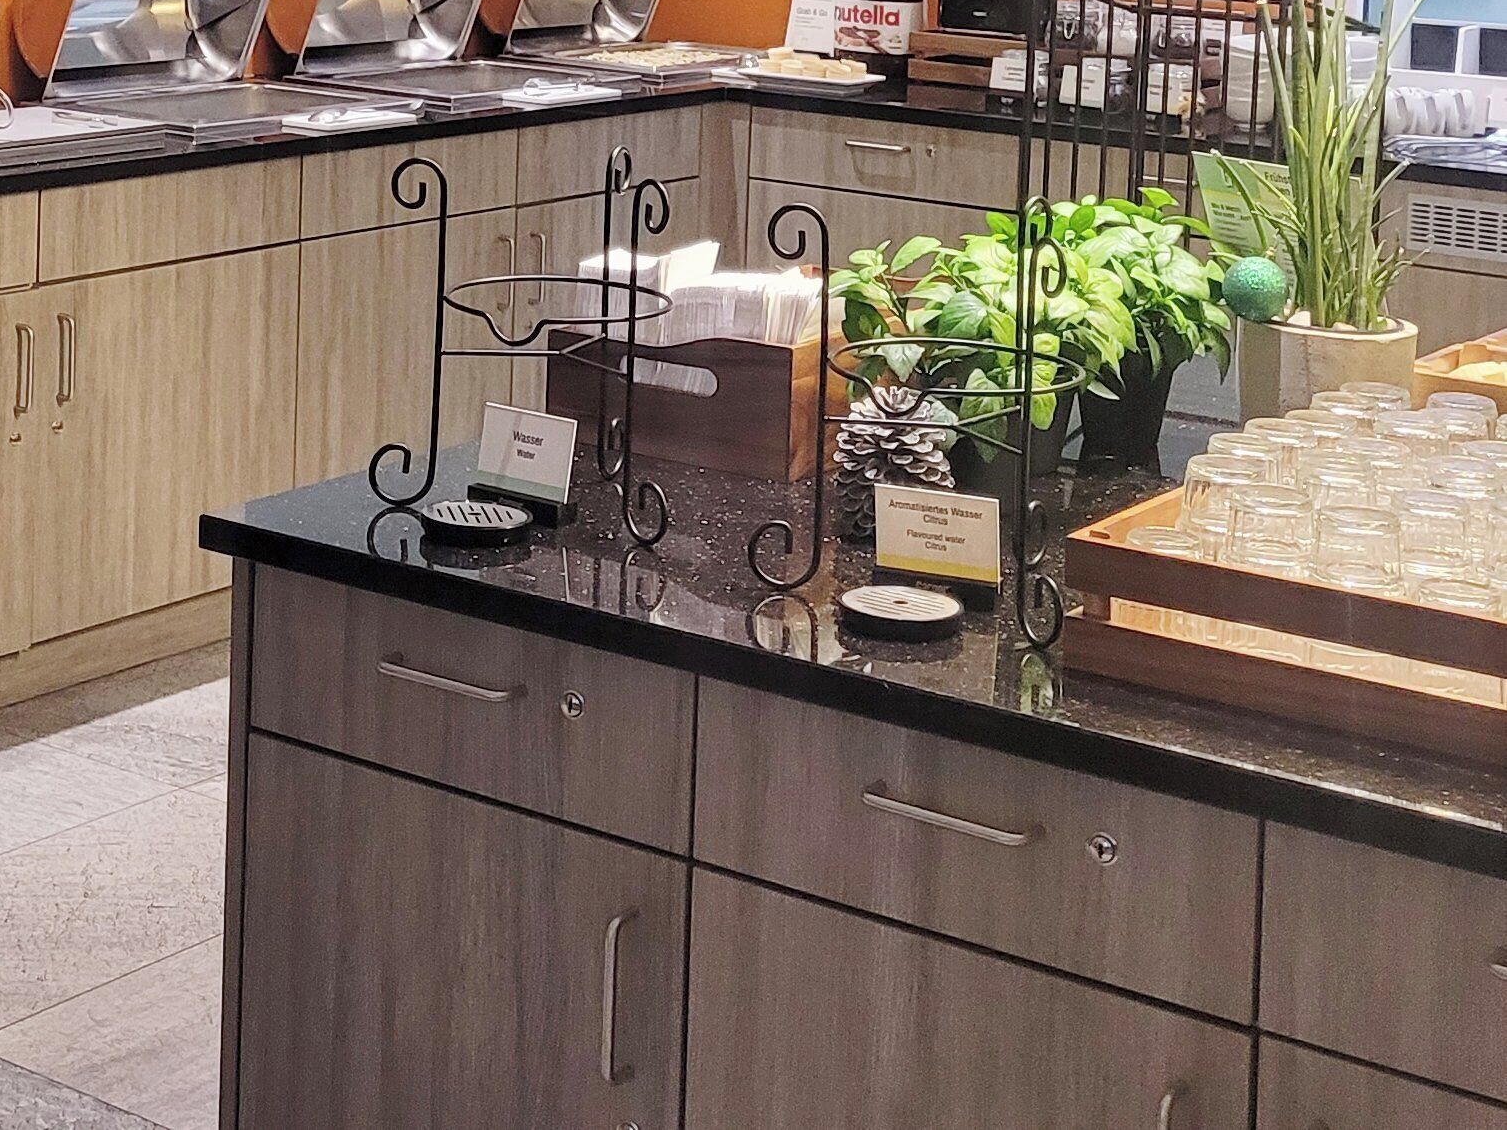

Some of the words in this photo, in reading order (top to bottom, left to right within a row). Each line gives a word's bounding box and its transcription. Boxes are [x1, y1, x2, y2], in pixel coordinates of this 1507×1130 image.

[834, 5, 900, 25] nutella
[513, 431, 544, 446] Wasser
[517, 449, 536, 459] Water
[888, 499, 949, 514] Aromatisiertes
[951, 507, 983, 519] Wasser
[923, 514, 949, 525] Citrus
[906, 529, 943, 541] Flavoured
[945, 535, 966, 544] water
[924, 541, 947, 551] Citrus
